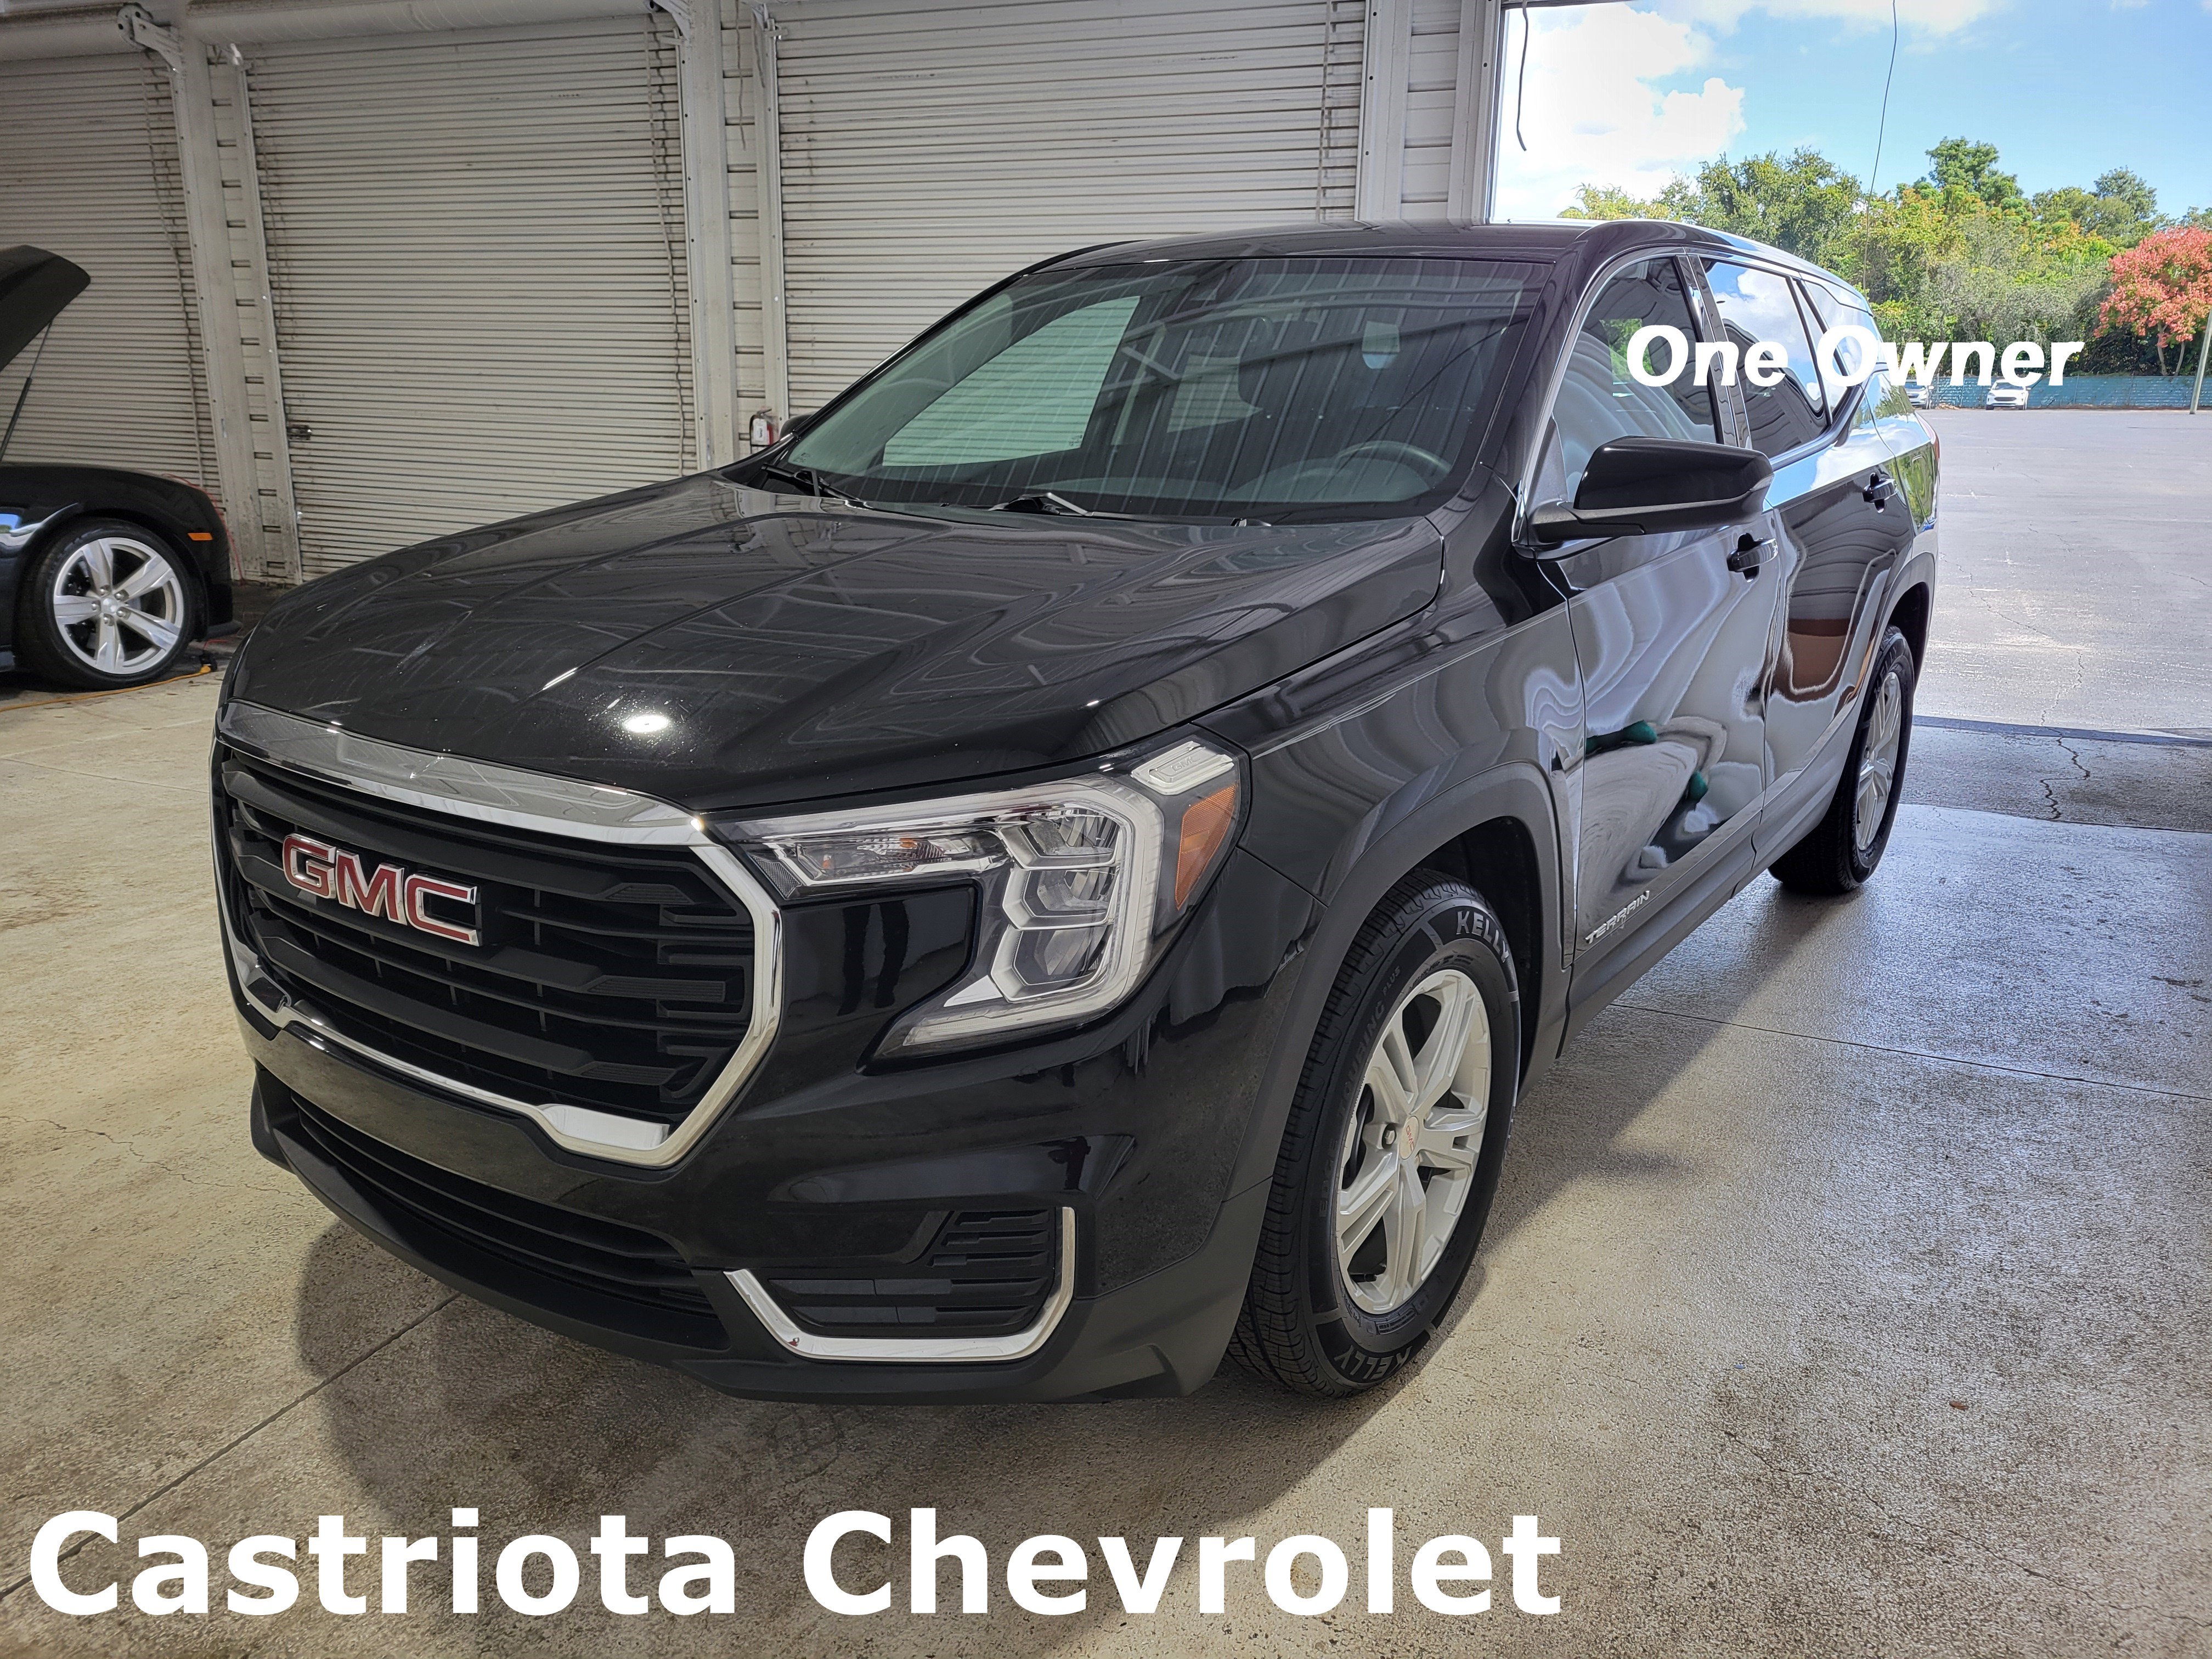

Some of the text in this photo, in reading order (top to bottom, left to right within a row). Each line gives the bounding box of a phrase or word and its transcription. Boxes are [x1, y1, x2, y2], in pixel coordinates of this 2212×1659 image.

[282, 833, 481, 947] GMC
[1455, 910, 1509, 963] KELLY
[1584, 890, 1650, 944] TERRAIN
[1382, 966, 1401, 996] PLUS
[1406, 1125, 1414, 1152] GMC
[1334, 1345, 1413, 1380] KELLY
